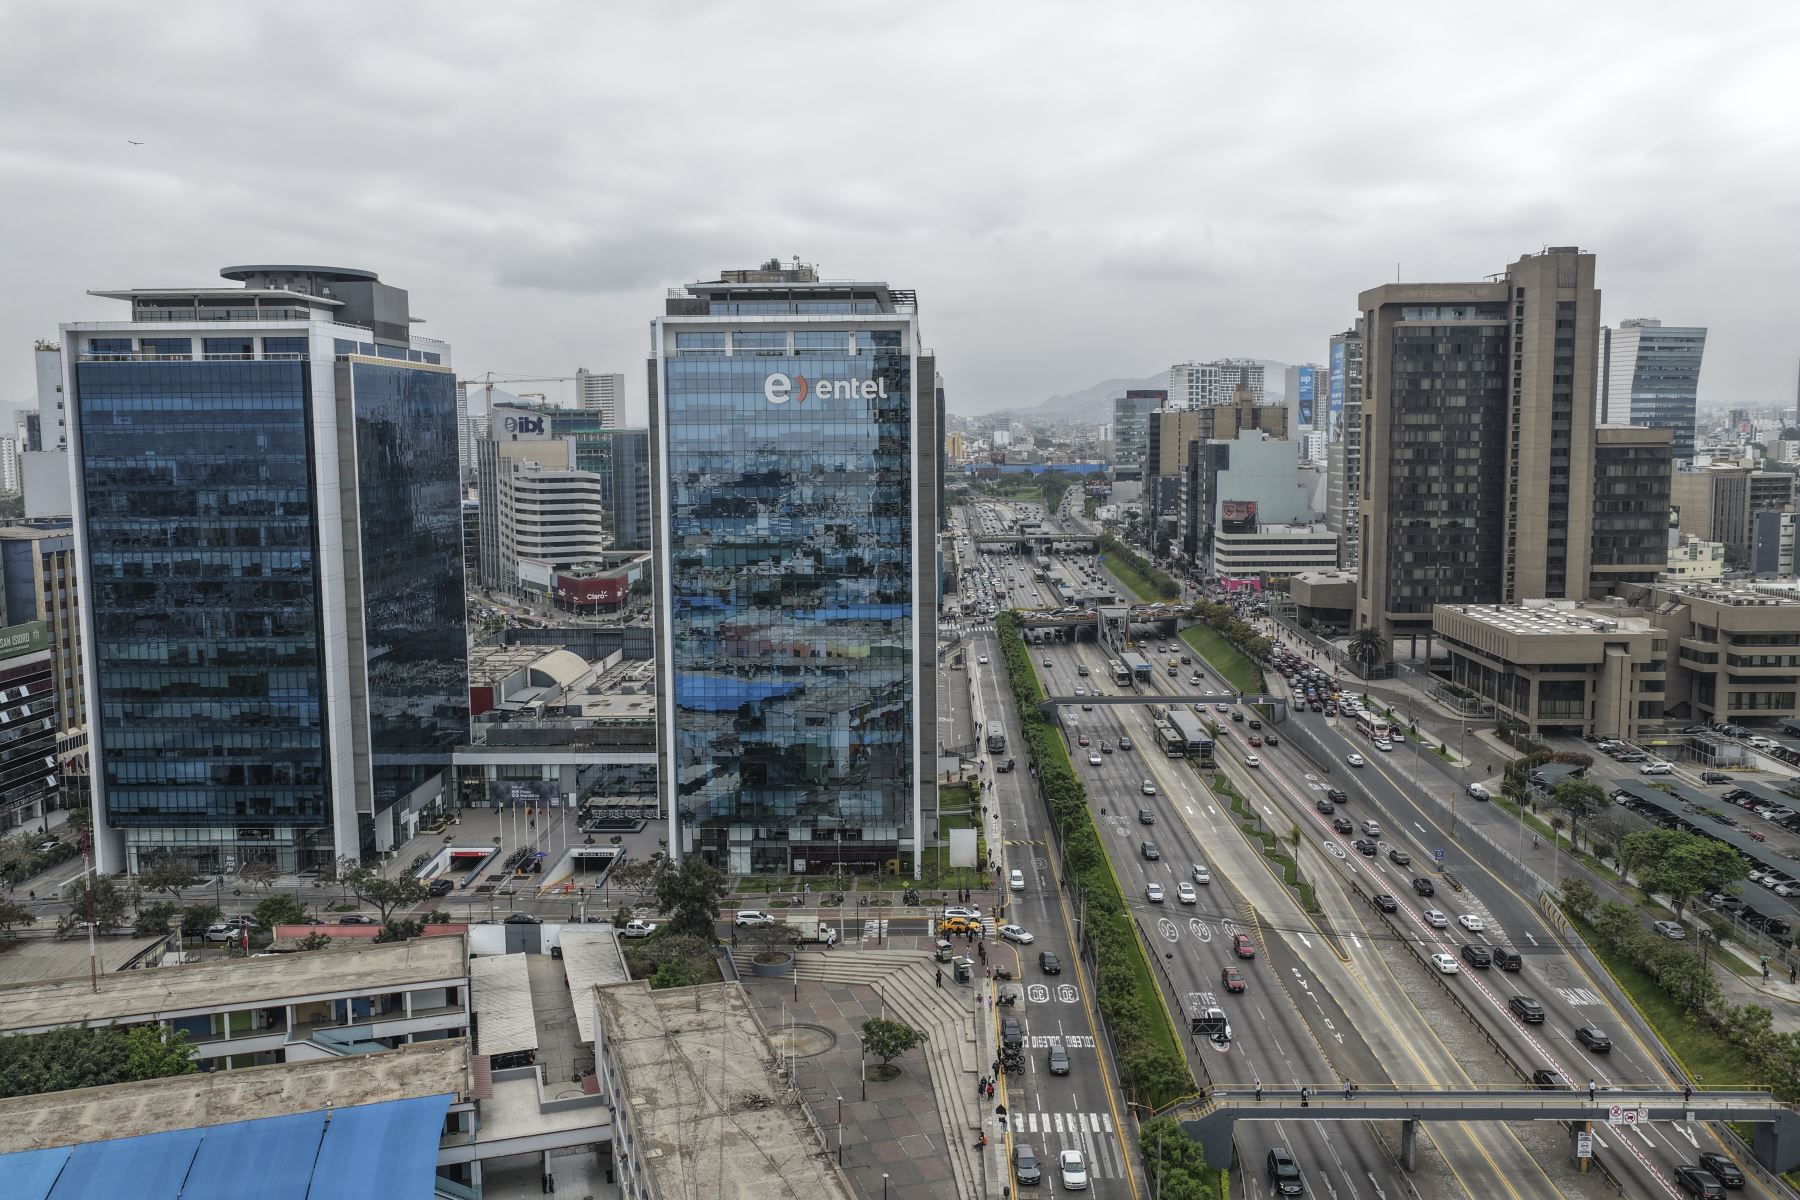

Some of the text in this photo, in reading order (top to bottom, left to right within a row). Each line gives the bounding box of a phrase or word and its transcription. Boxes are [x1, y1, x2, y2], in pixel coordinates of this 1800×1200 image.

[816, 377, 887, 399] entel
[518, 416, 544, 433] ibt
[587, 592, 604, 600] Claro
[11, 632, 30, 645] ISIDRO
[1161, 923, 1176, 937] 50
[1193, 923, 1207, 936] 80
[1033, 990, 1045, 1001] 30
[1062, 990, 1074, 1001] 30
[1556, 988, 1605, 1006] SALIDA
[1031, 1036, 1061, 1048] COLEGIO
[1065, 1036, 1095, 1048] COLEGIO
